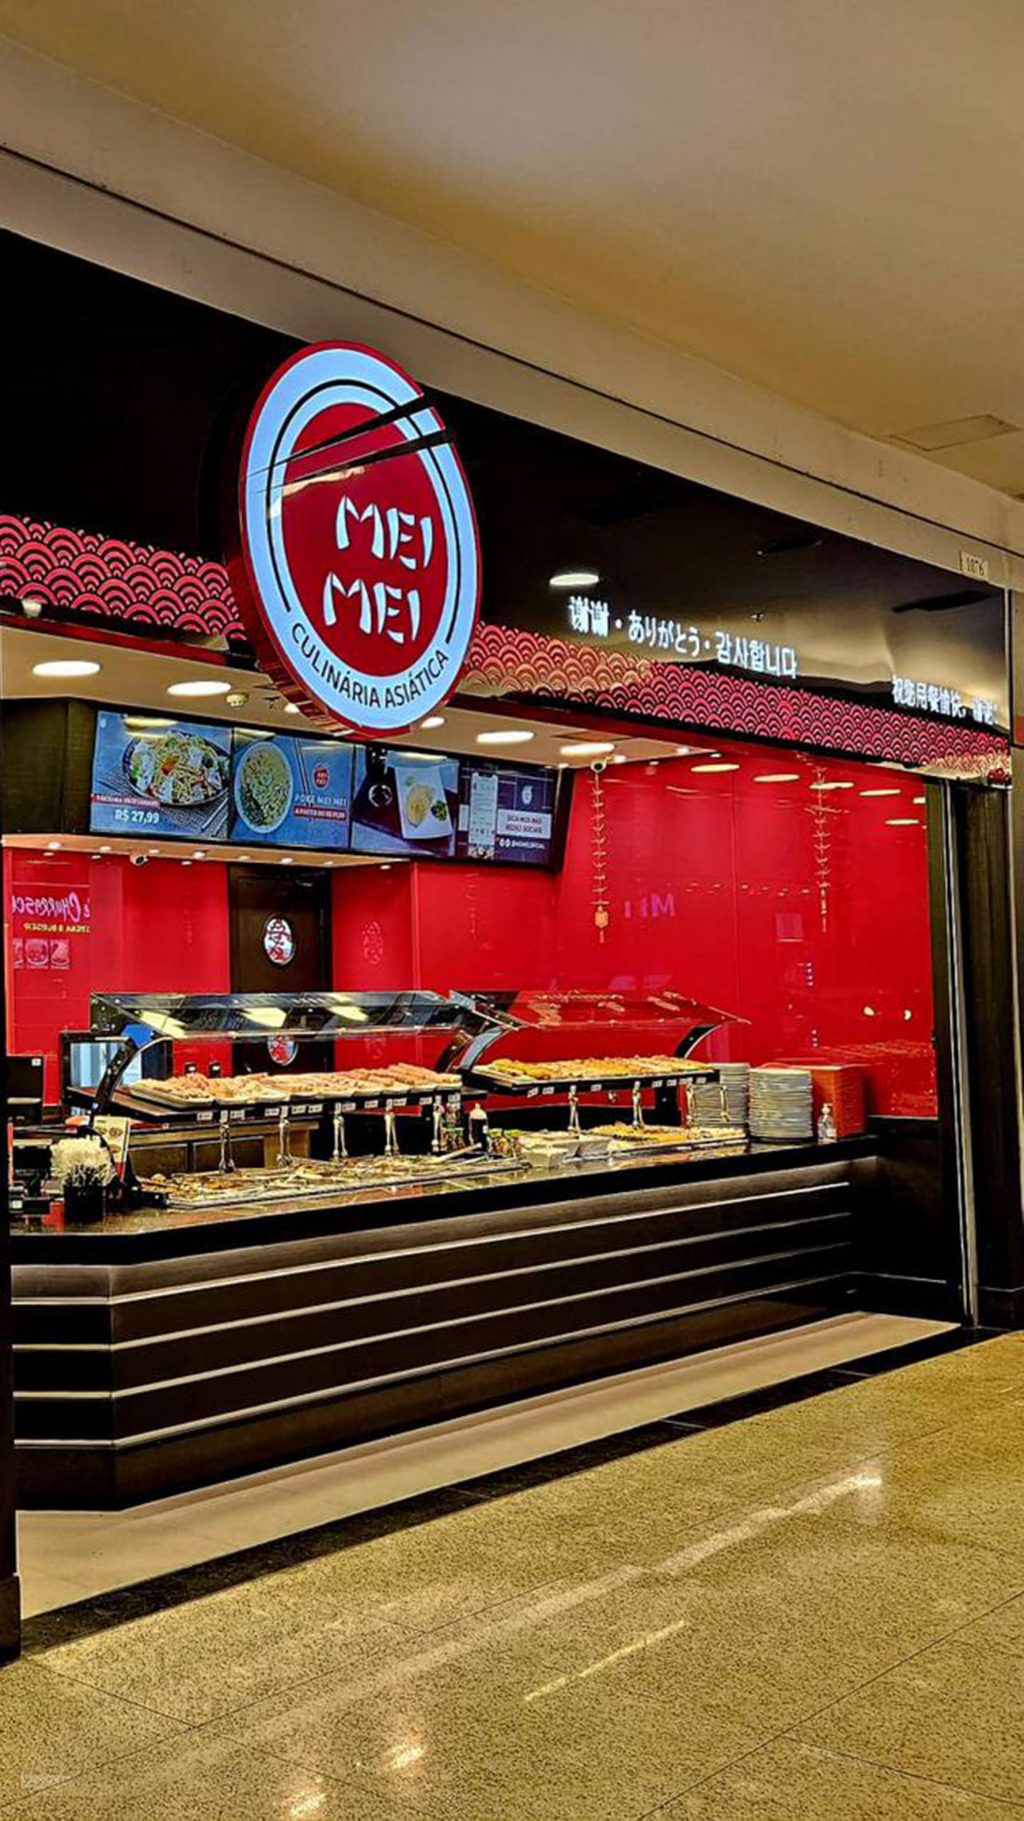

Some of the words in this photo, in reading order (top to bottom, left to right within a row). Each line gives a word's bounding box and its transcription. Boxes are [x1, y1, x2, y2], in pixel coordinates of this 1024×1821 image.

[336, 495, 434, 570] MEI
[323, 571, 420, 644] MEI
[628, 609, 700, 657] ありがとう
[714, 631, 798, 679] 감사합니다
[291, 623, 381, 708] CULINÁRIA
[385, 649, 449, 708] ASIÁTICA
[115, 809, 129, 823] R$
[131, 810, 160, 824] 27,99
